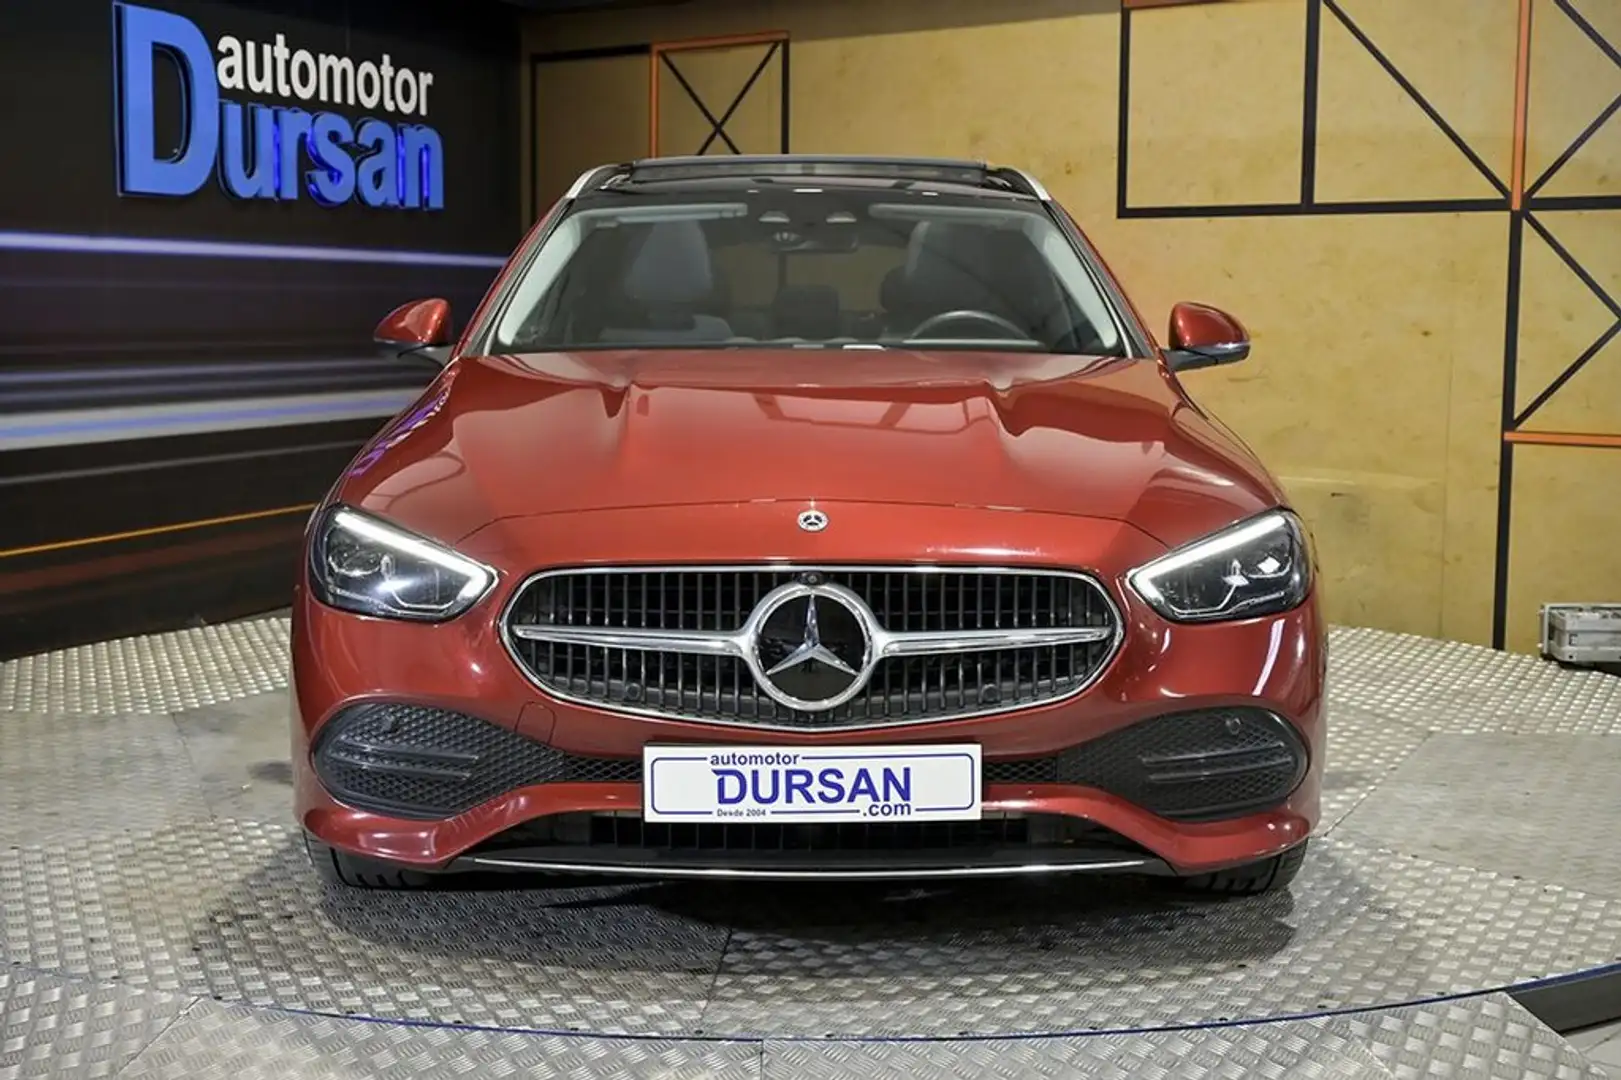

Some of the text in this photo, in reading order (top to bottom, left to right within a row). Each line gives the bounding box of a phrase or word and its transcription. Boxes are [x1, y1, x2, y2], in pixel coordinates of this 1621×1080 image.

[217, 33, 433, 116] automotor
[113, 1, 444, 211] Dursan
[710, 752, 800, 767] automotor
[711, 767, 912, 805] DURSAN
[717, 808, 767, 818] Desde 2004
[862, 802, 912, 818] .com
